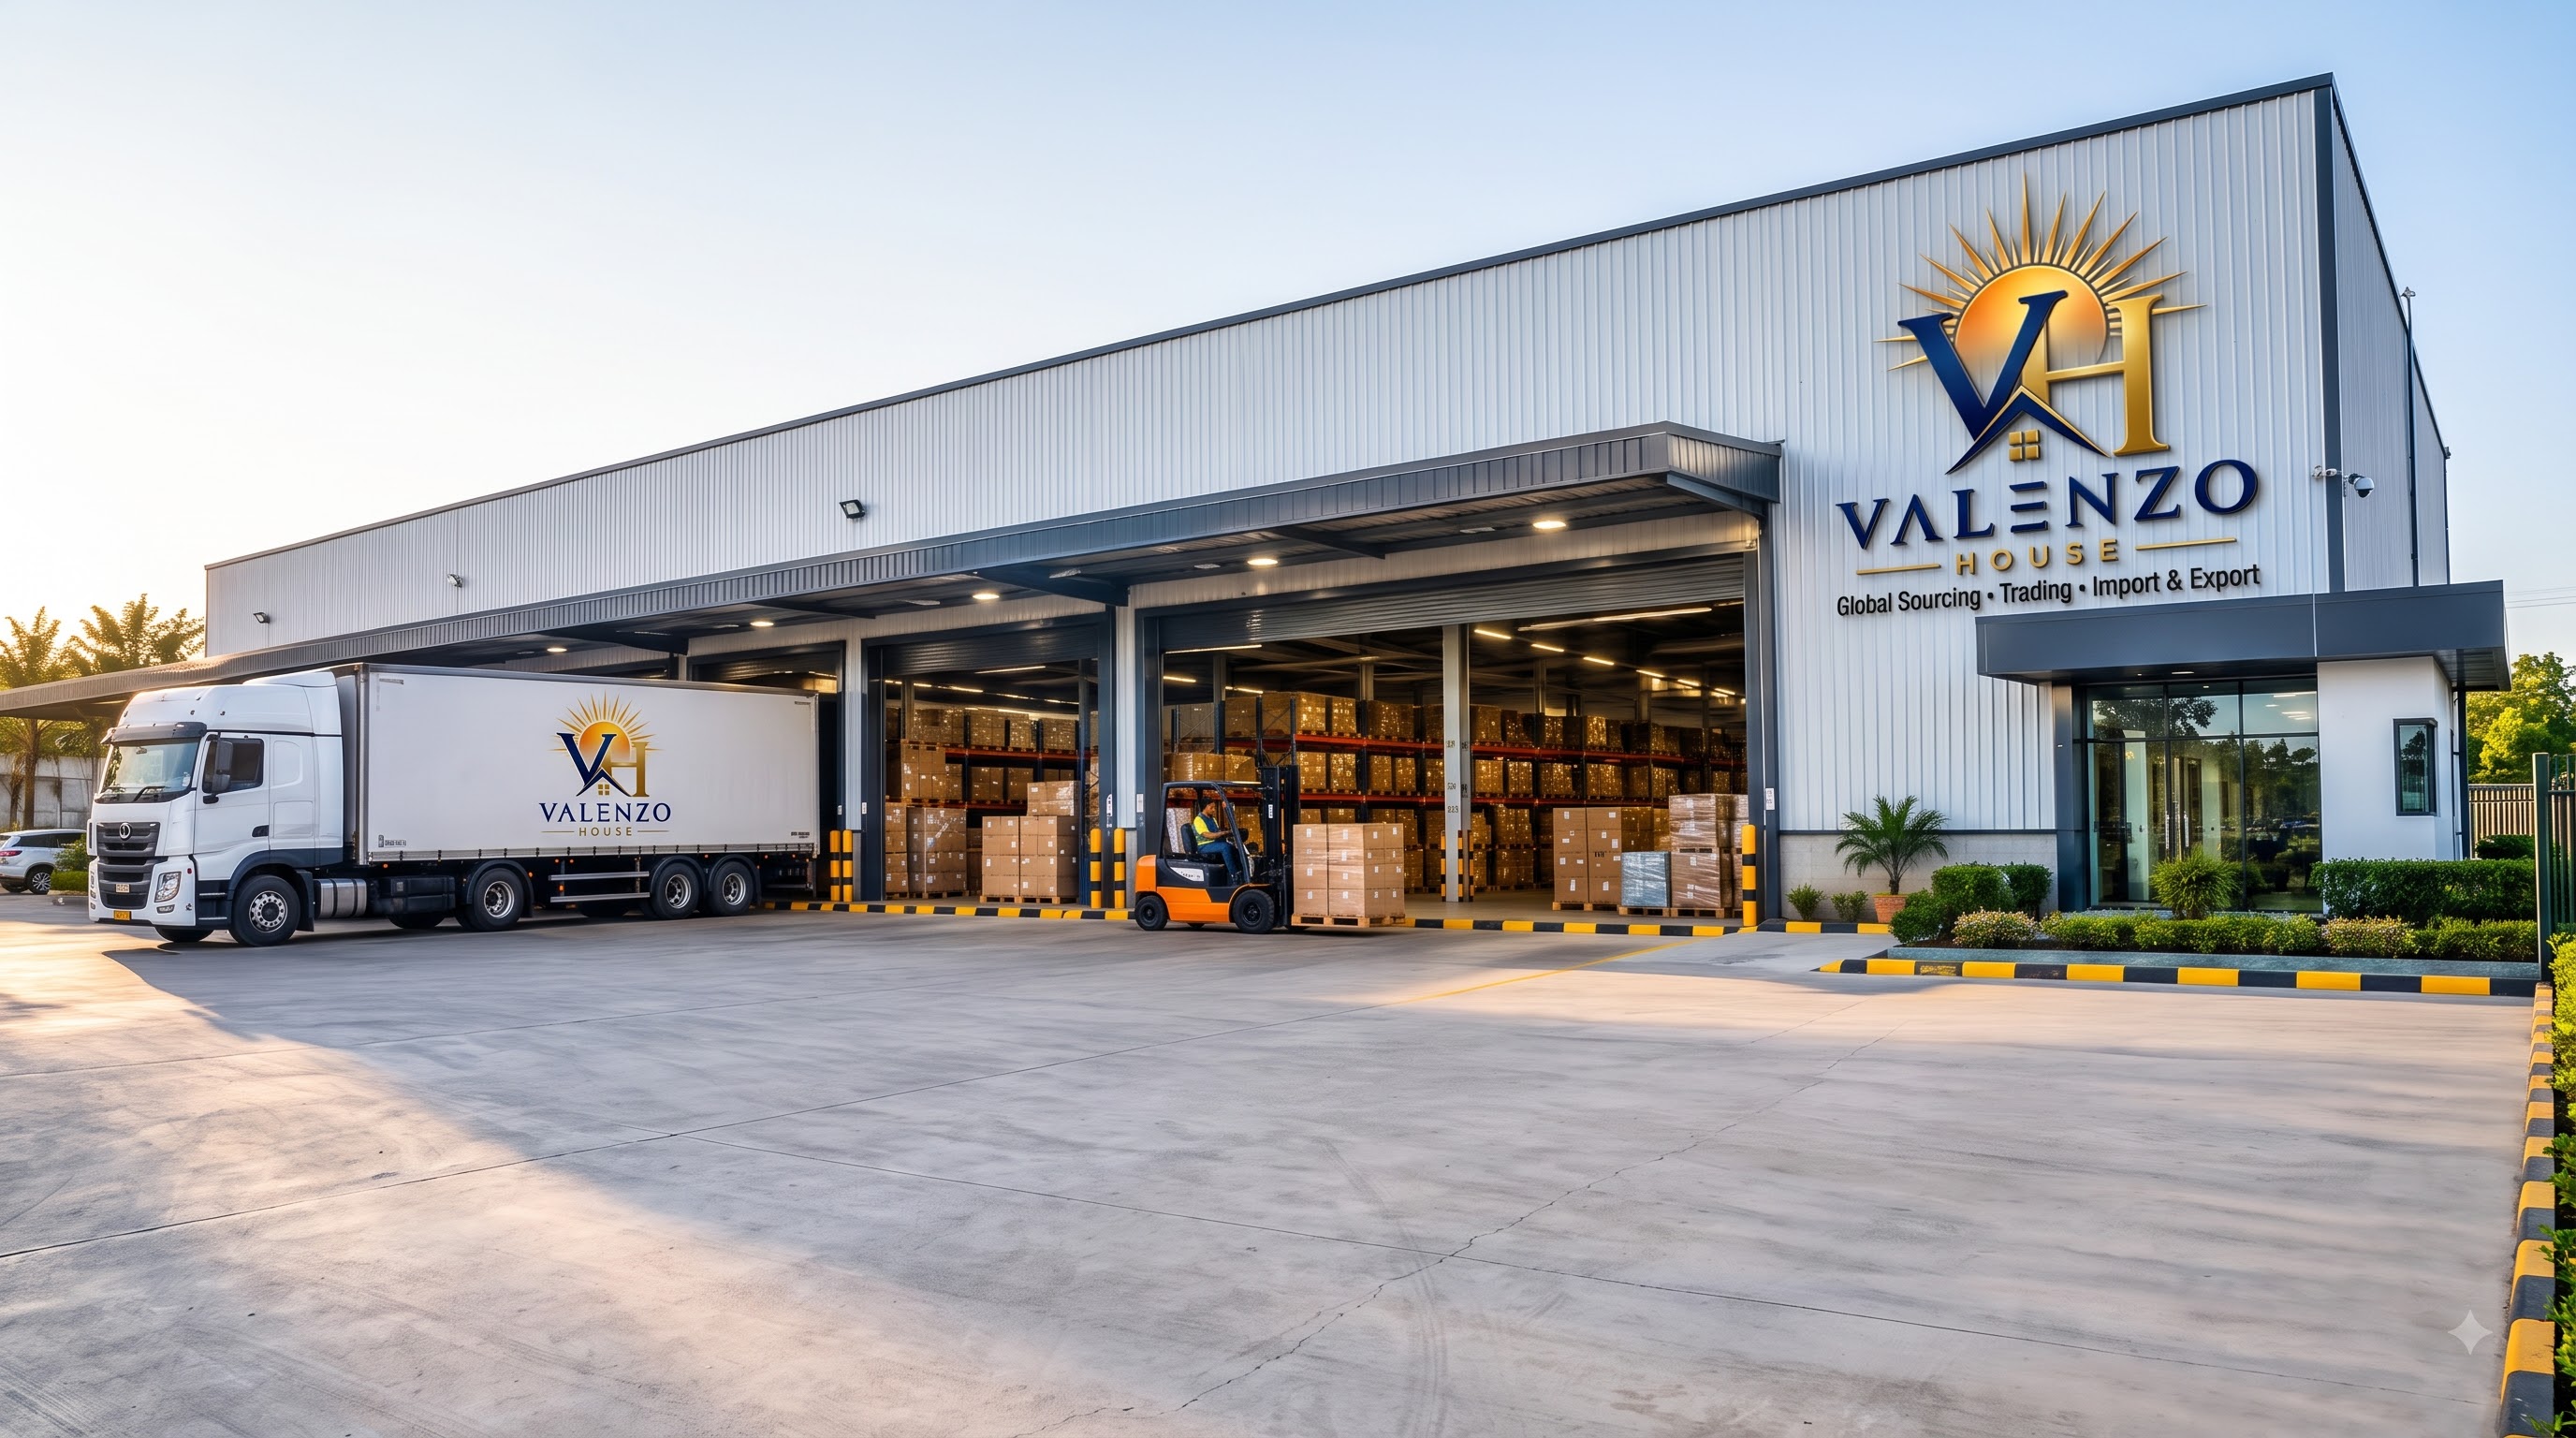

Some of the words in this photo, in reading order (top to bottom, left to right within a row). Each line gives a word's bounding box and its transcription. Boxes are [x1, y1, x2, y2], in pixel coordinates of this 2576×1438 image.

[1836, 459, 2259, 550] VALENZO
[1956, 538, 2119, 576] HOUSE
[1837, 593, 1893, 617] Global
[1898, 587, 1982, 611] Sourcing
[1999, 580, 2072, 604] Trading
[2093, 572, 2160, 600] Import
[2166, 569, 2184, 592] &
[2190, 564, 2261, 593] Export
[539, 802, 671, 823] VALENZO
[578, 827, 633, 837] HOUSE
